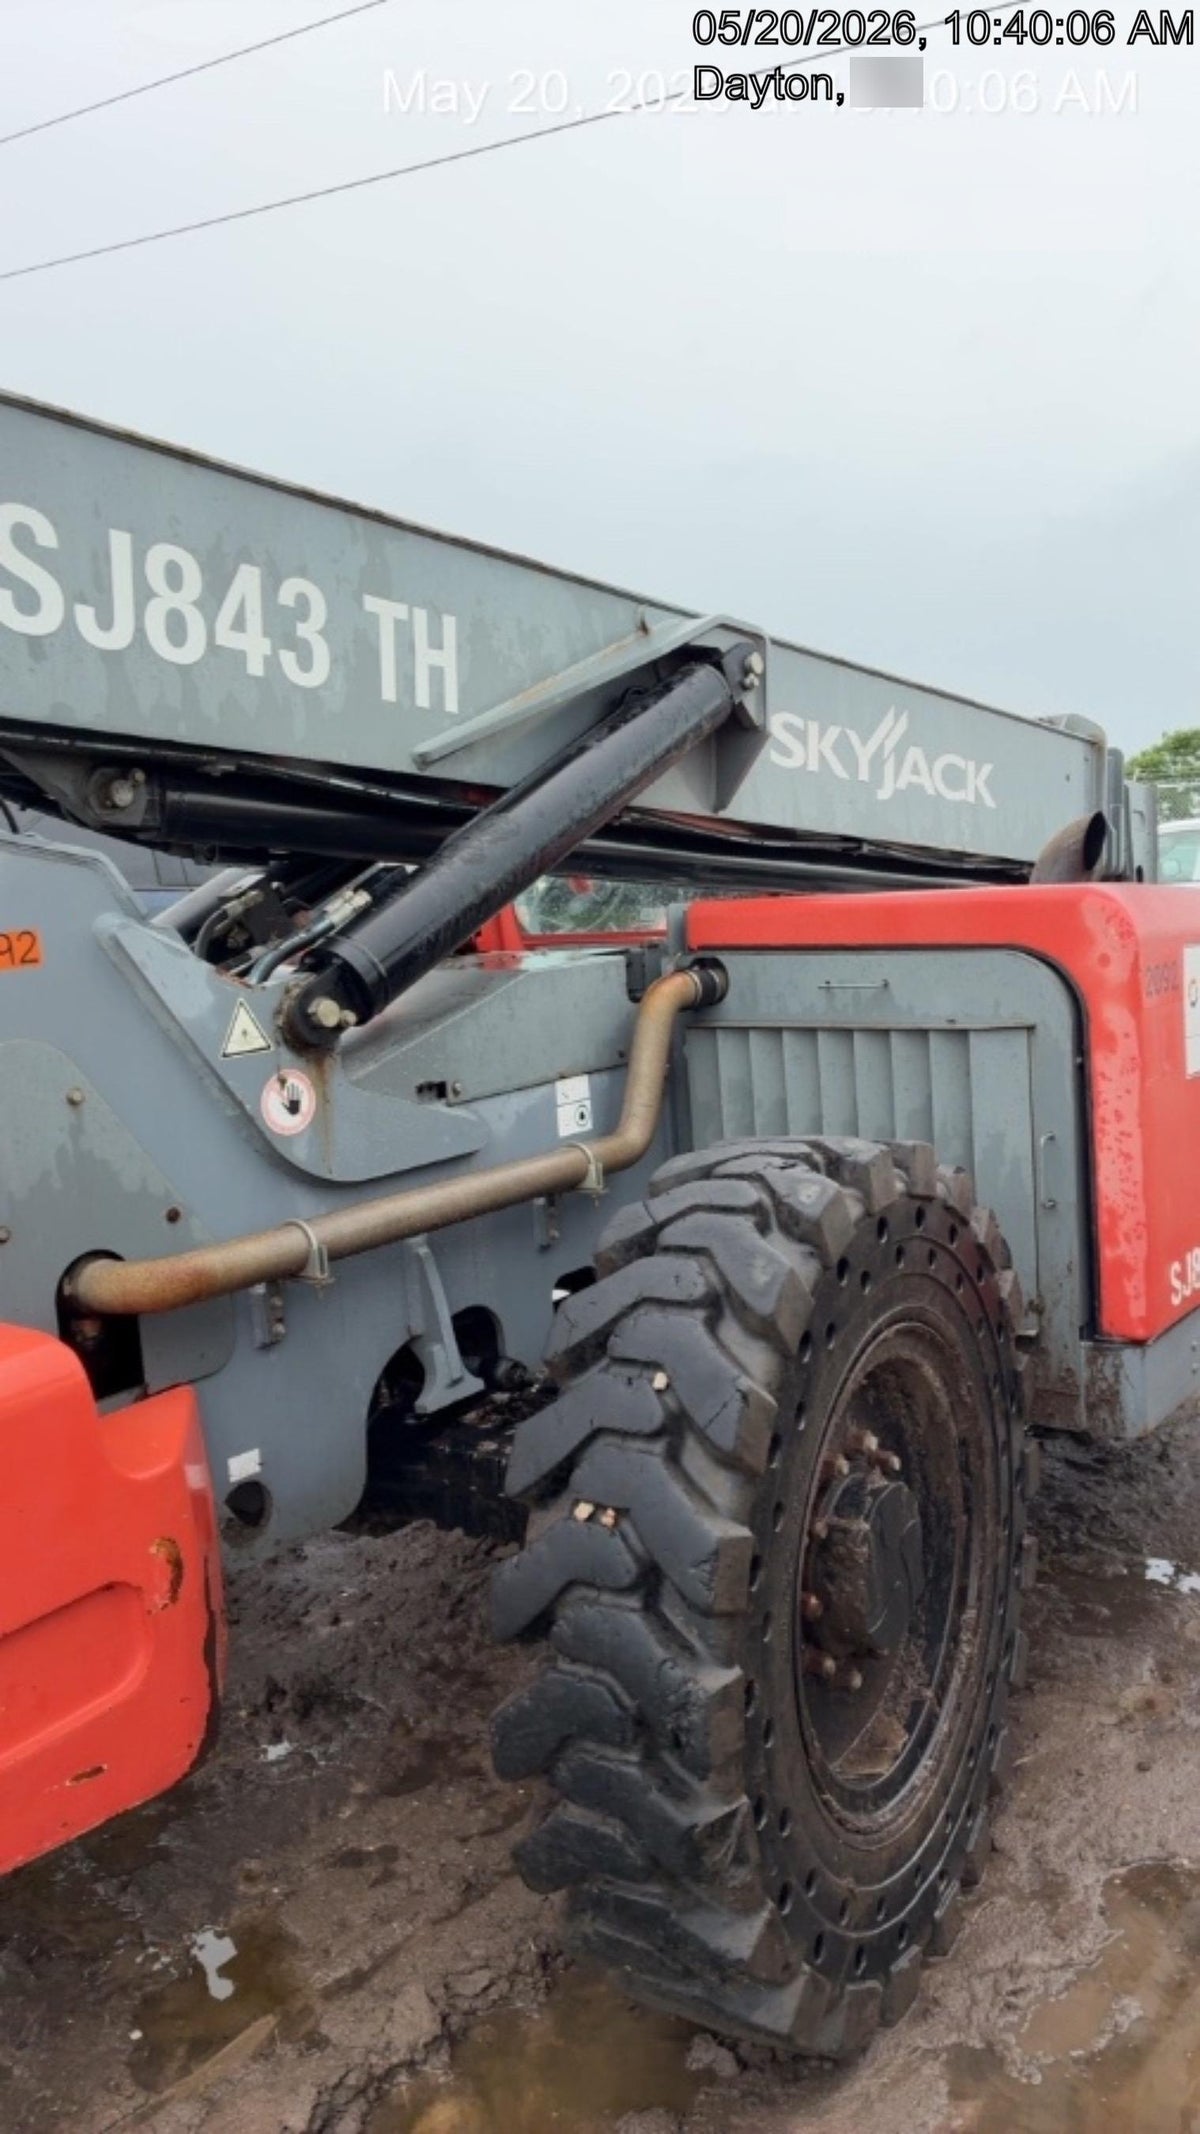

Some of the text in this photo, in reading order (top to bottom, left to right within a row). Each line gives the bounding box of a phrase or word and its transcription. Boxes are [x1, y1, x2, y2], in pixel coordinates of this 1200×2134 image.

[0, 502, 459, 714] SJ843 TH
[769, 705, 997, 809] SKYJACK
